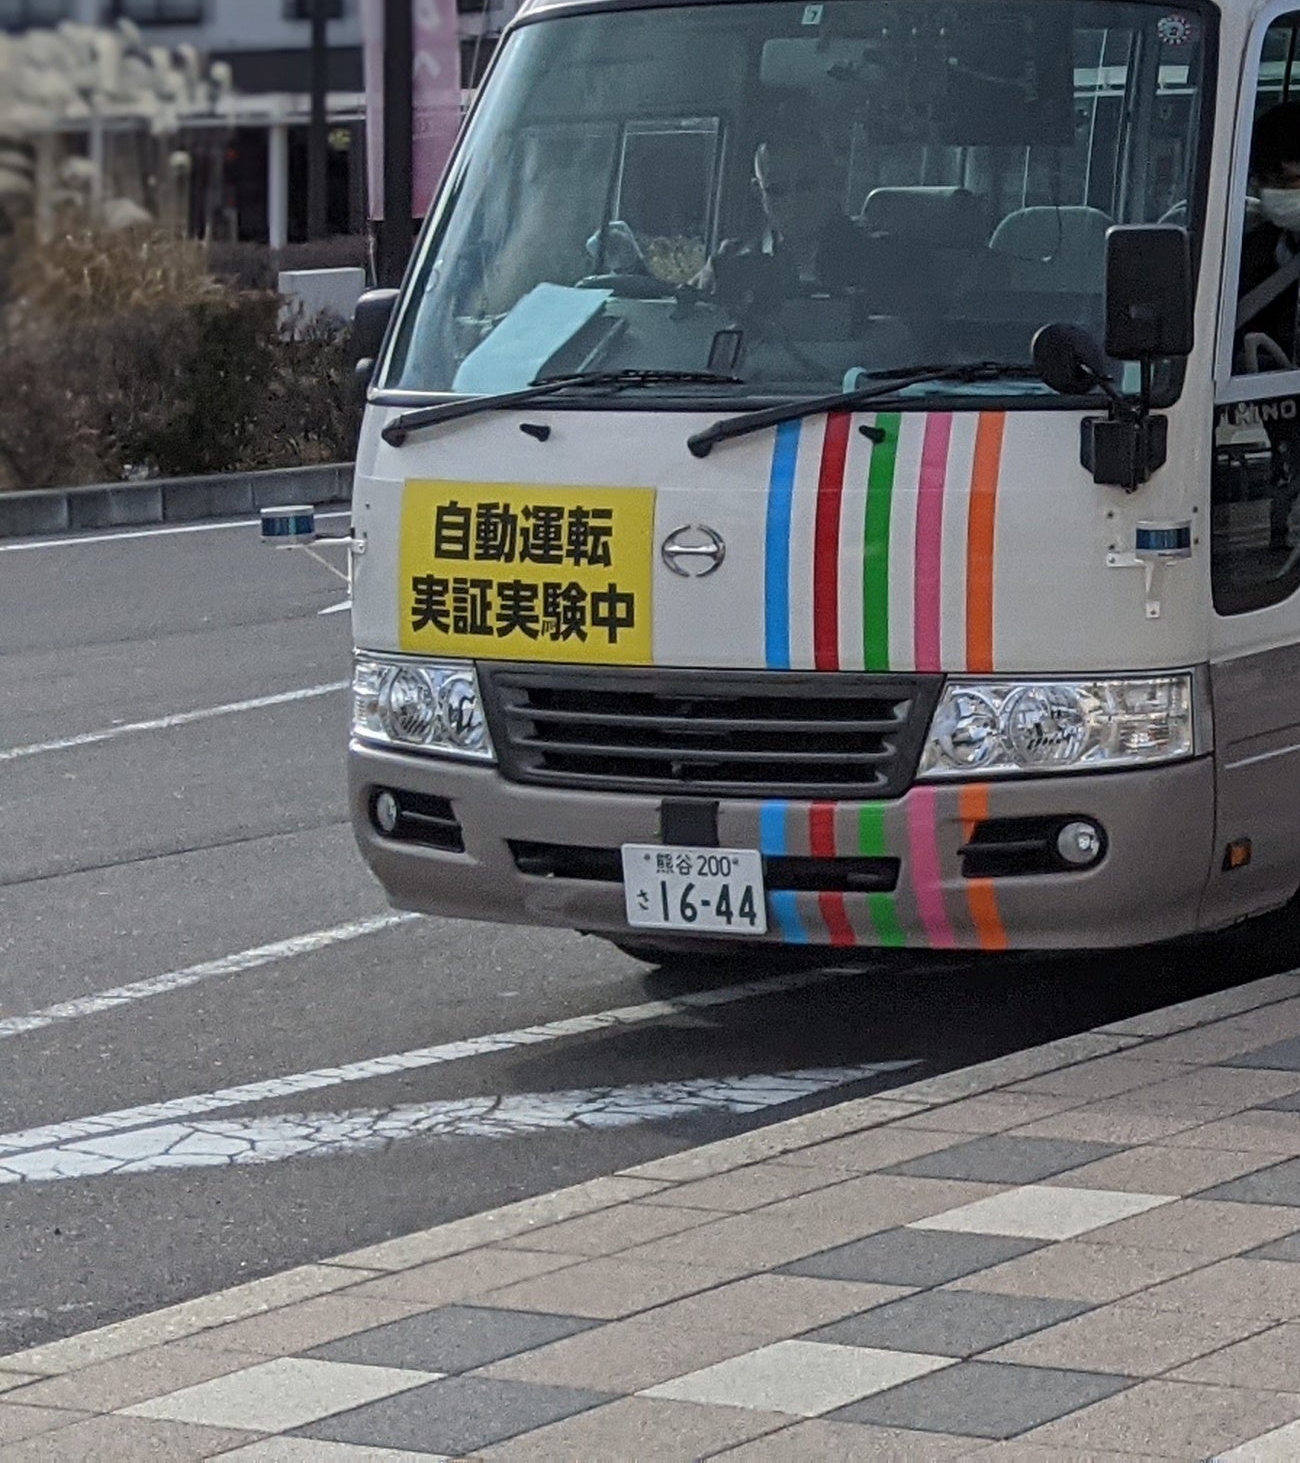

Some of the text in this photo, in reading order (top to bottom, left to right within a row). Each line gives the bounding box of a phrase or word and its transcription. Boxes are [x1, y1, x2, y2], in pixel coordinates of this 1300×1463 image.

[434, 500, 614, 568] 自動運転
[410, 574, 636, 644] 実証実験中
[656, 853, 732, 877] 熊谷 200
[637, 880, 757, 926] さ 16-44
